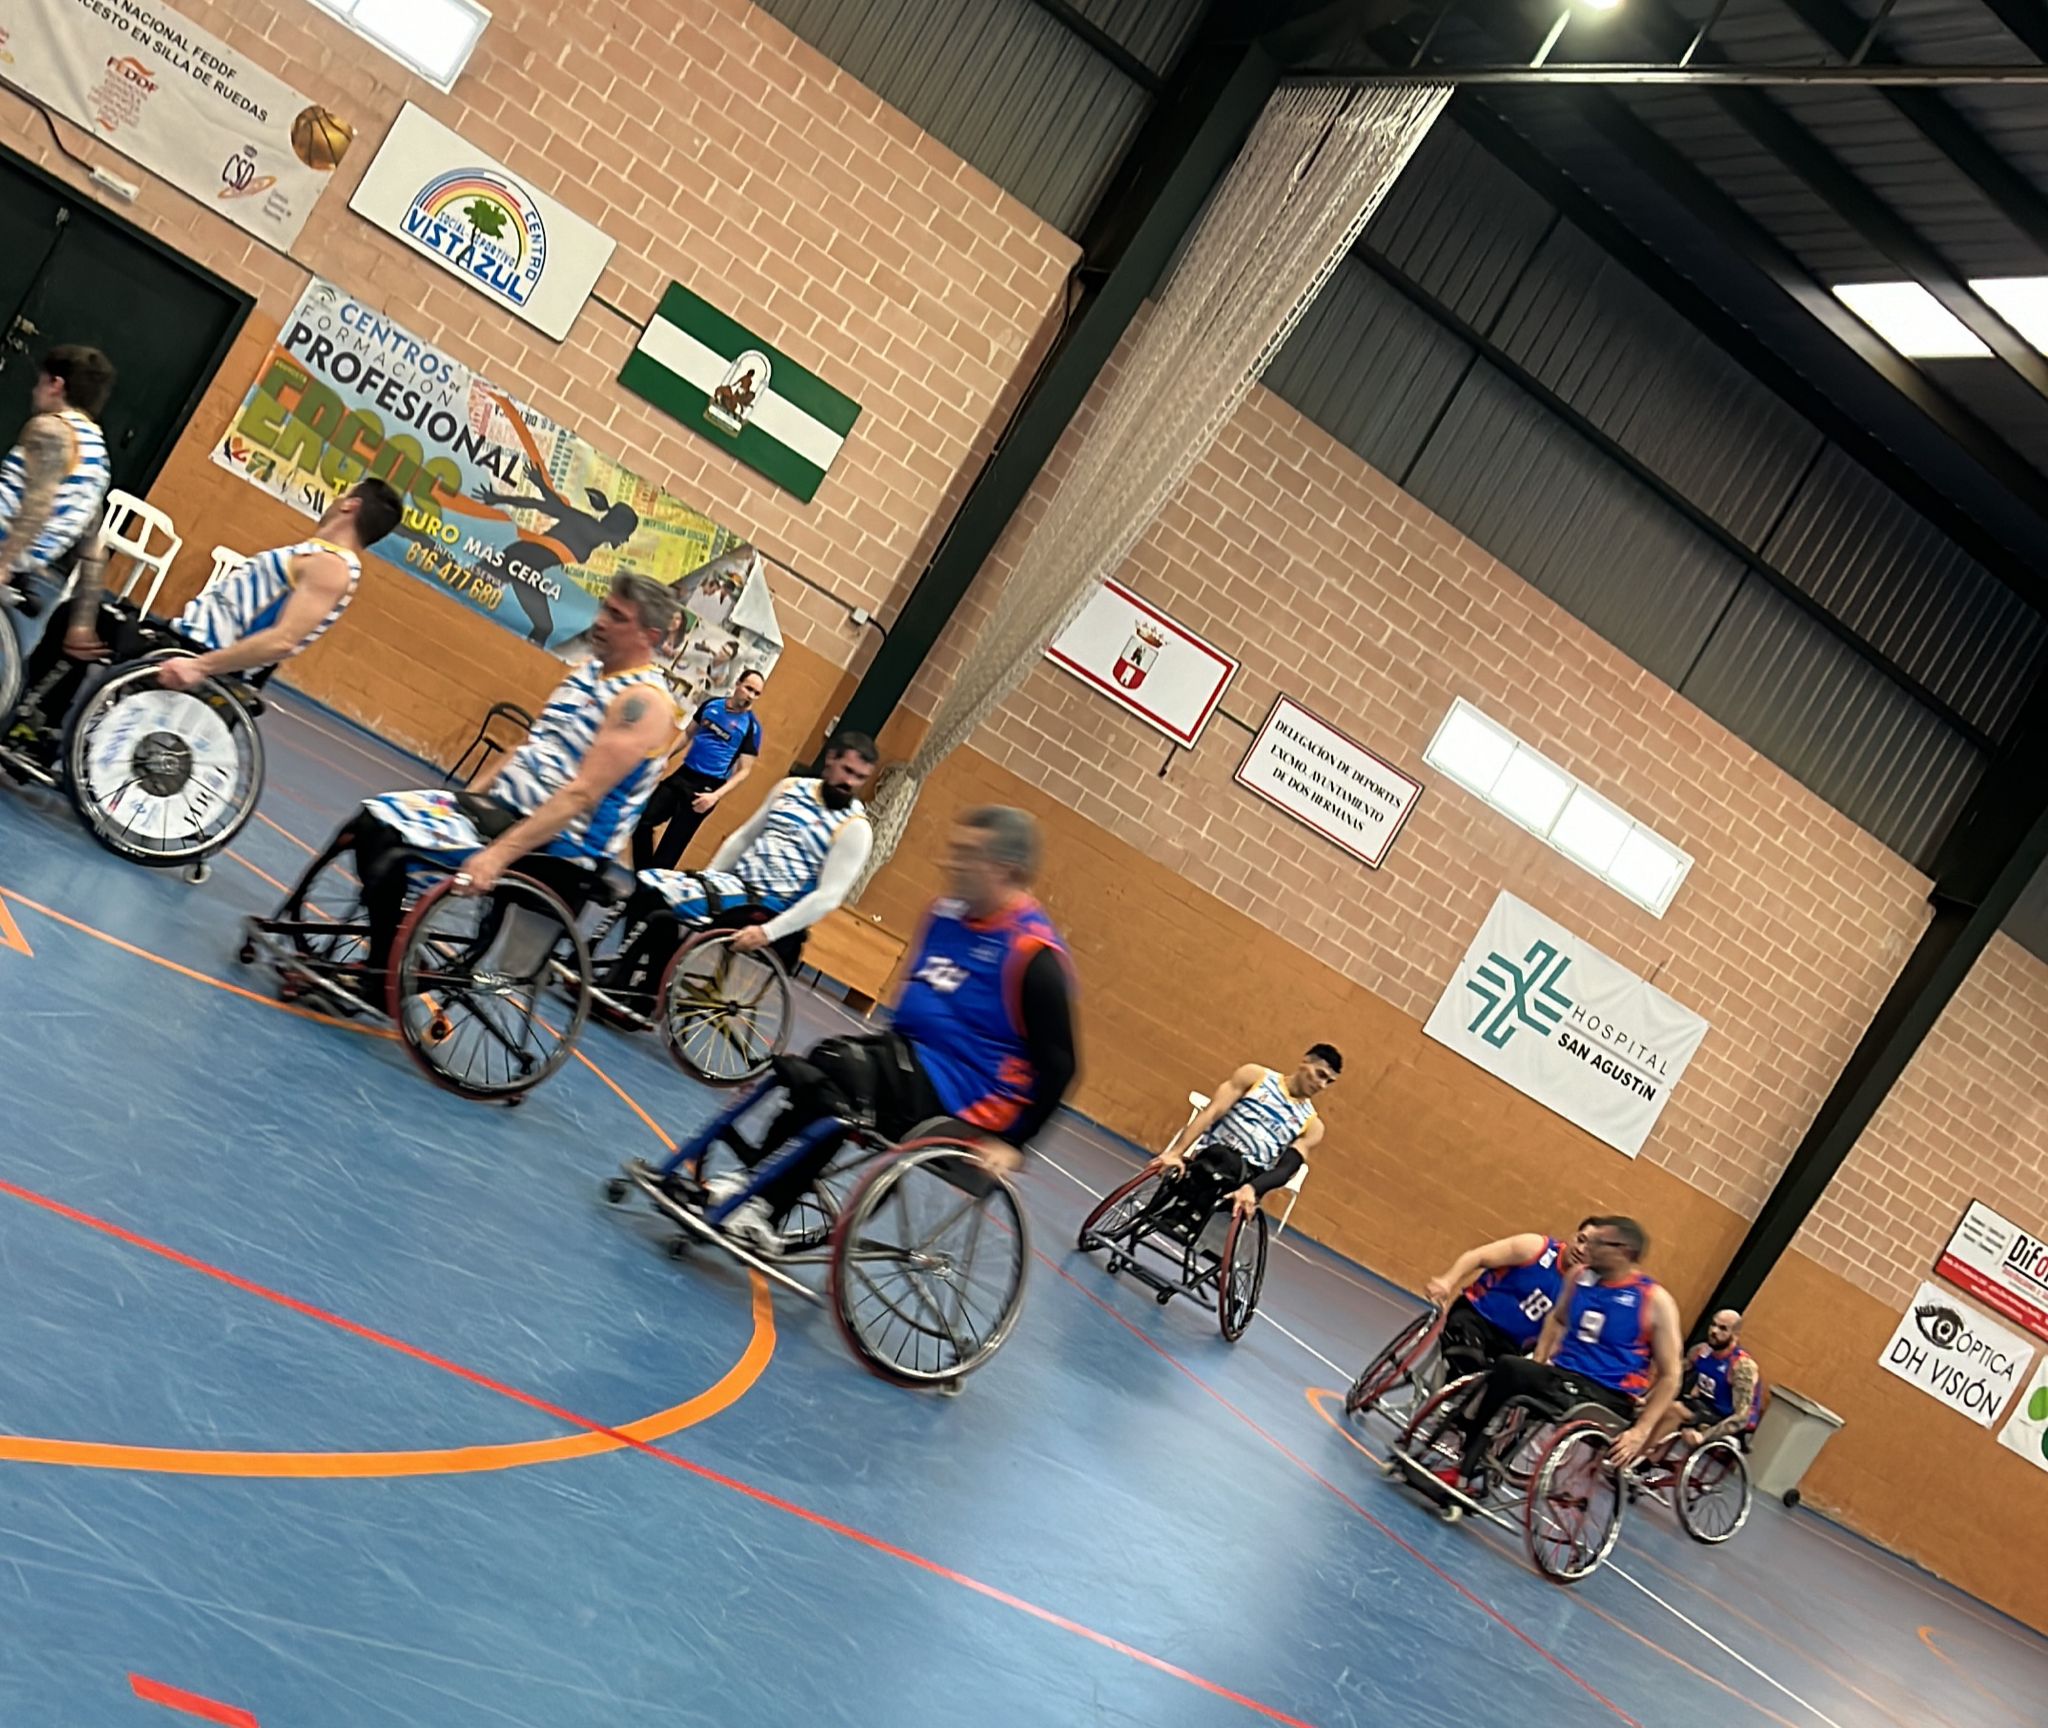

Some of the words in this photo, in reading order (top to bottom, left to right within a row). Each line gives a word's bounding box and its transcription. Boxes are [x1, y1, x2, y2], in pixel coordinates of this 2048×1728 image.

[78, 0, 130, 31] CESTO
[130, 26, 152, 46] EN
[152, 41, 190, 73] SILLA
[192, 69, 213, 87] DE
[213, 81, 268, 123] RUEDAS
[121, 0, 189, 52] NACIONAL
[193, 46, 237, 80] FEDDF
[222, 153, 255, 191] CSD
[407, 208, 524, 302] VISTAZUL
[525, 210, 543, 281] CENTRO
[340, 303, 453, 385] CENTROS
[284, 321, 520, 488] PROFESIONAL
[437, 561, 471, 591] 477
[468, 578, 503, 611] 680
[463, 536, 505, 567] MÁS
[508, 560, 562, 601] CERCA
[1270, 743, 1308, 776] EXCMO.
[1310, 769, 1385, 823] AYUNTAMIENTO
[1272, 766, 1290, 782] DE
[1287, 776, 1311, 798] DOS
[1310, 791, 1364, 831] HERMANAS
[1336, 759, 1353, 776] DE
[1351, 769, 1402, 808] DEPORTES
[1557, 1032, 1591, 1061] SAN
[1572, 1005, 1668, 1076] HOSPITAL
[1519, 1288, 1553, 1321] 18
[1890, 1337, 1930, 1375] DH
[1931, 1358, 2003, 1418] VISIÓN
[1956, 1330, 2016, 1381] ÓPTICA
